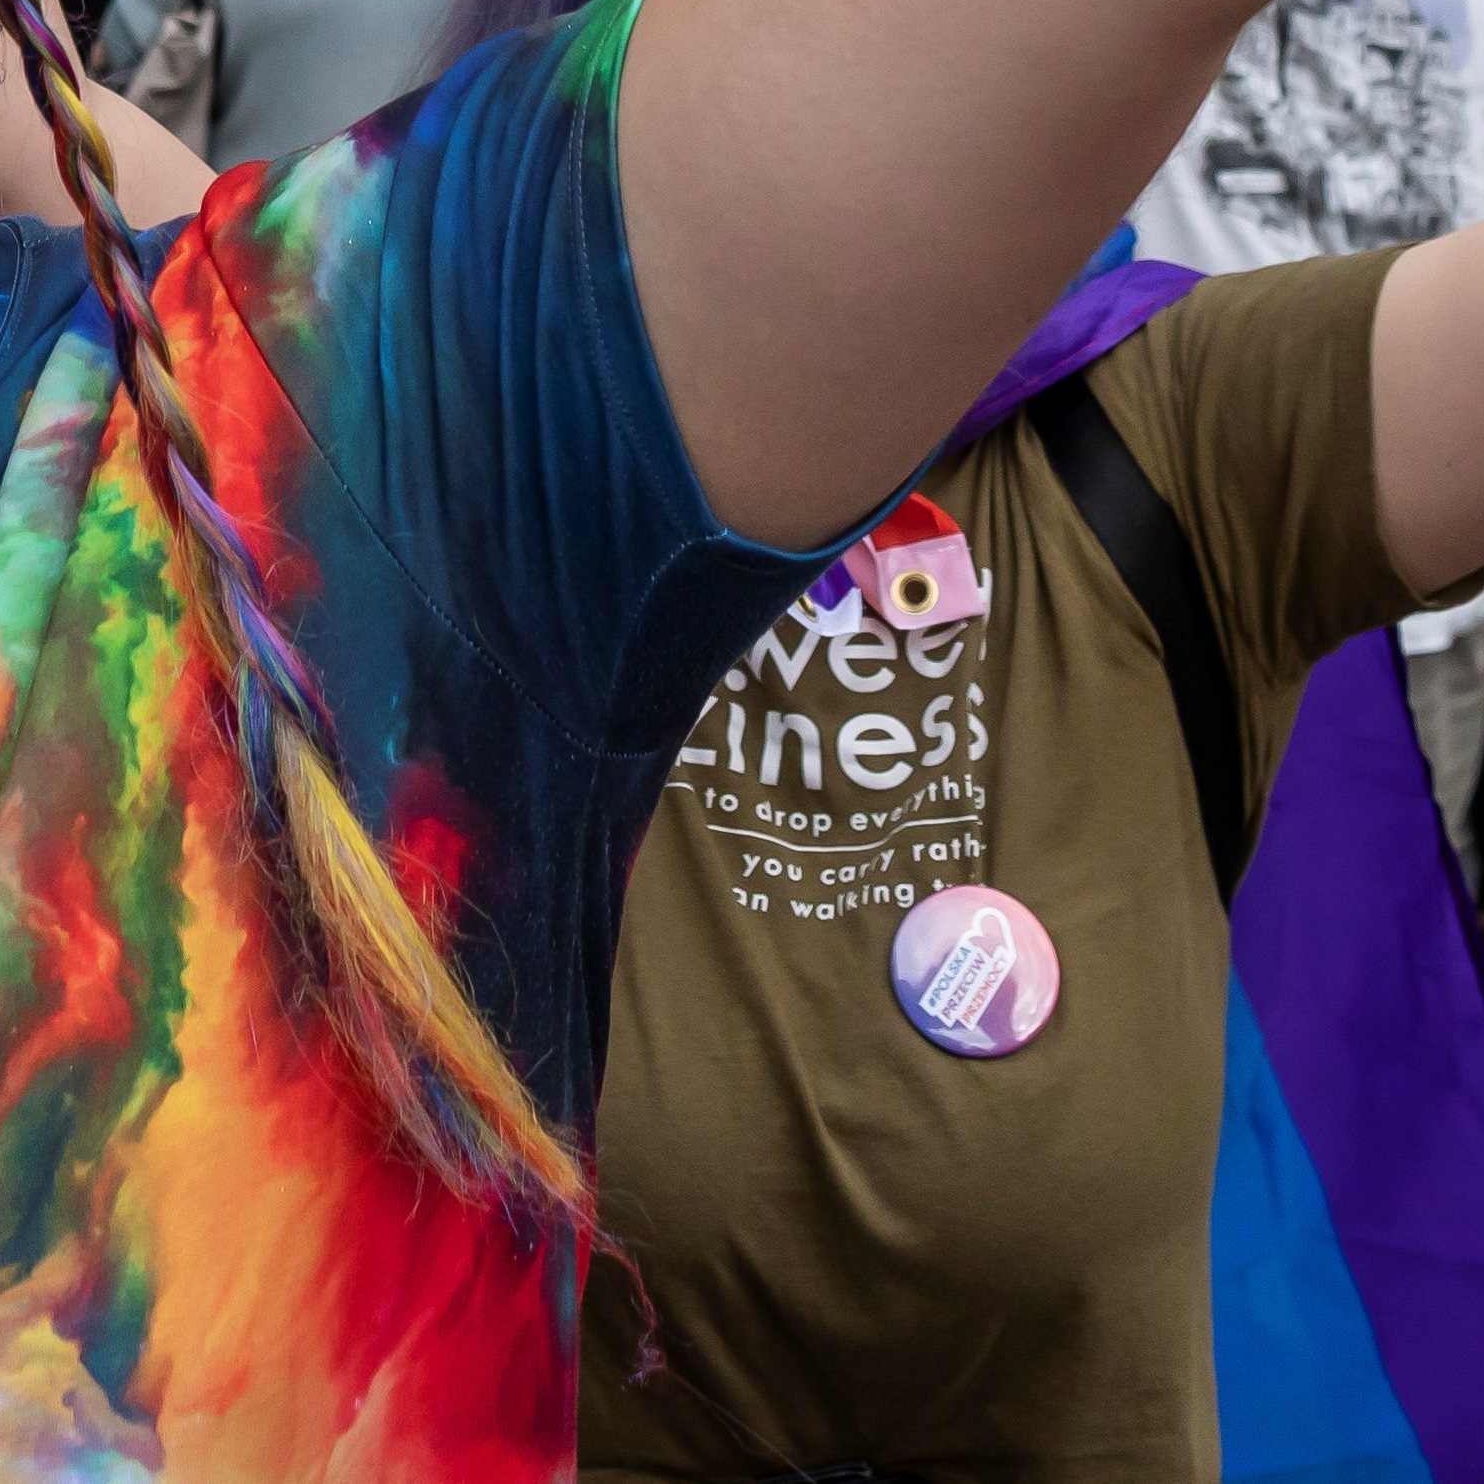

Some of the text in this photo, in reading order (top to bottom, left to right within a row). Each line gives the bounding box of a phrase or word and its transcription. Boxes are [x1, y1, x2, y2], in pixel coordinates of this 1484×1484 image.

[704, 786, 739, 812] to
[755, 800, 832, 838] drop
[742, 853, 804, 883] you
[790, 883, 915, 920] walking
